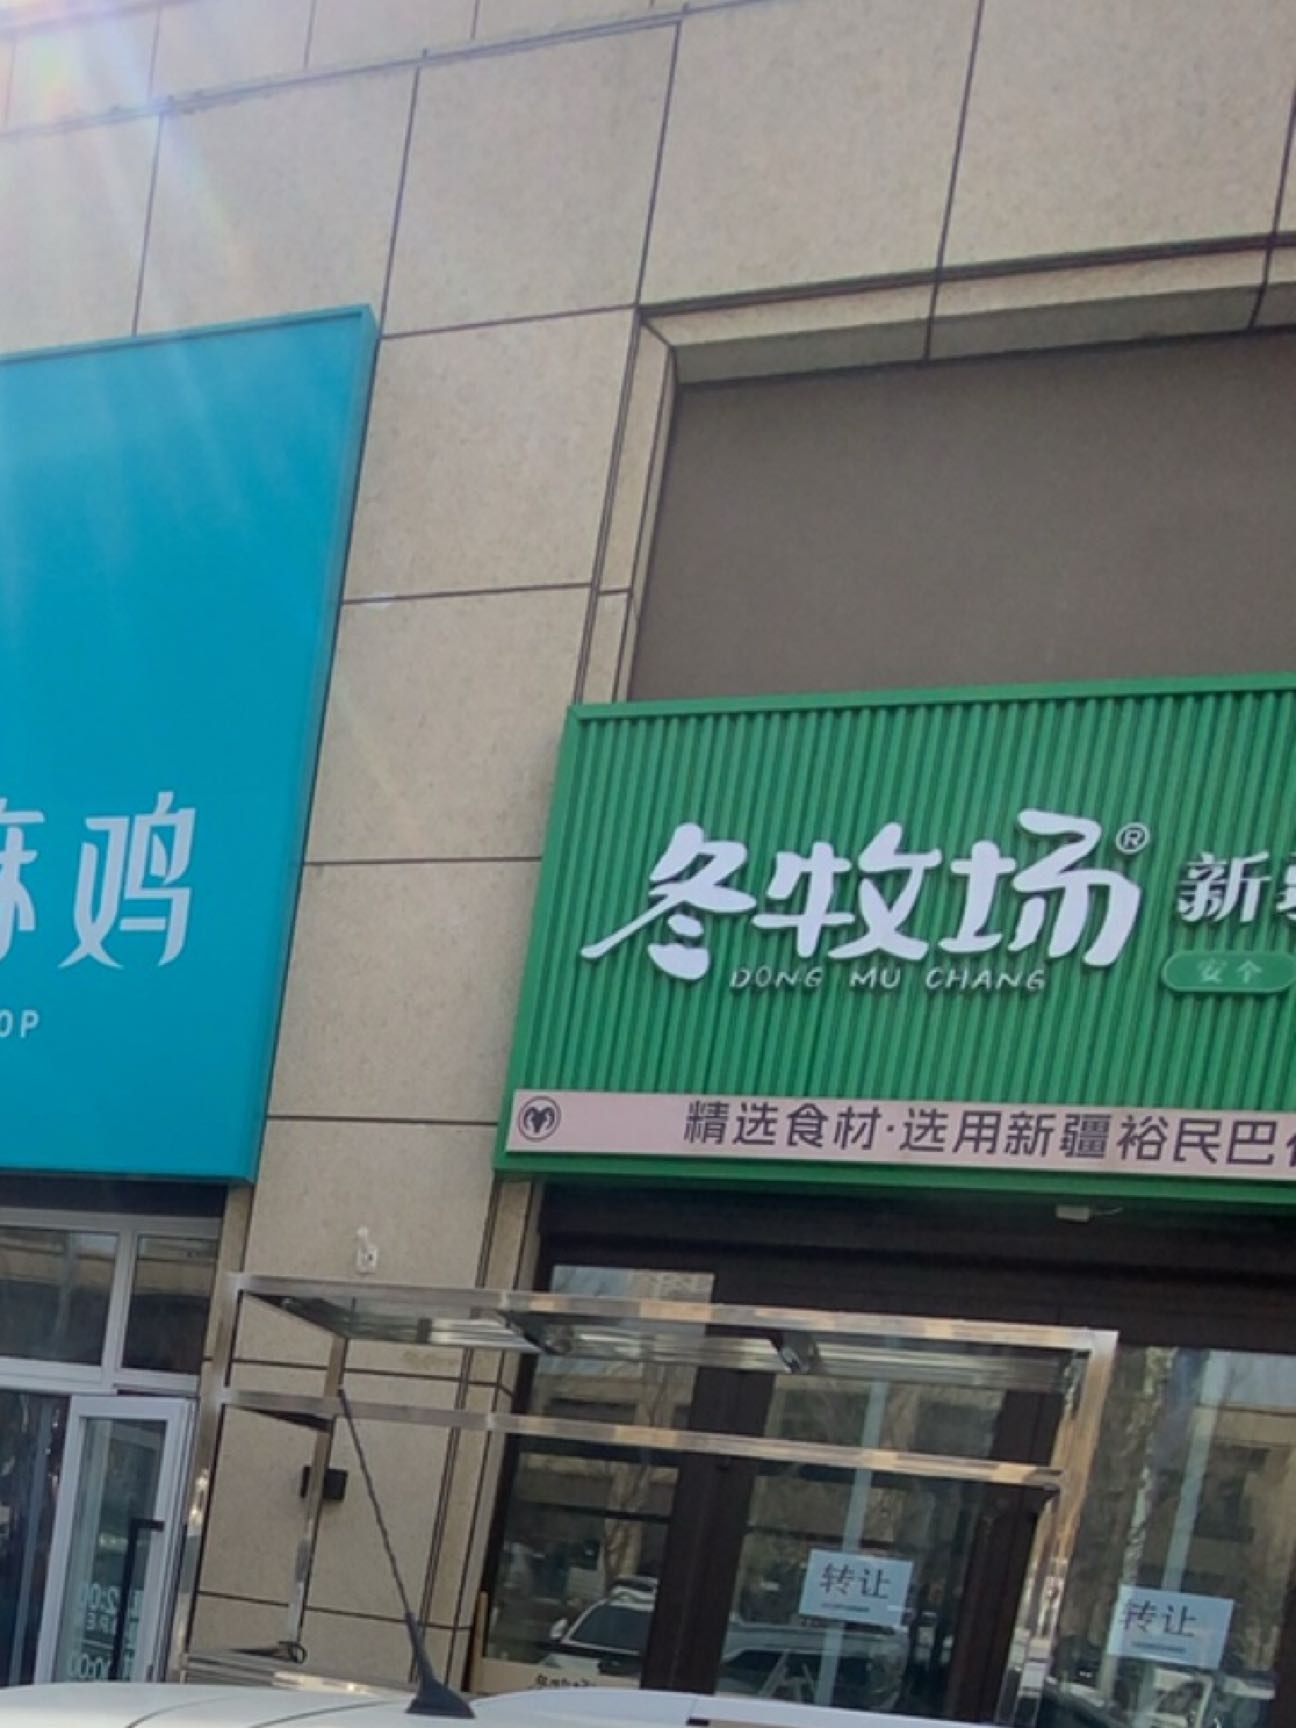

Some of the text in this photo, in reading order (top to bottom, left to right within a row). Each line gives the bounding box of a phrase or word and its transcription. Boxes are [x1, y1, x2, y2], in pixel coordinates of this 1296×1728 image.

[580, 808, 1142, 980] 冬牧场
[730, 967, 1047, 991] DONG MU CHANG
[820, 1563, 891, 1599] 转让
[1122, 1599, 1196, 1638] 转让
